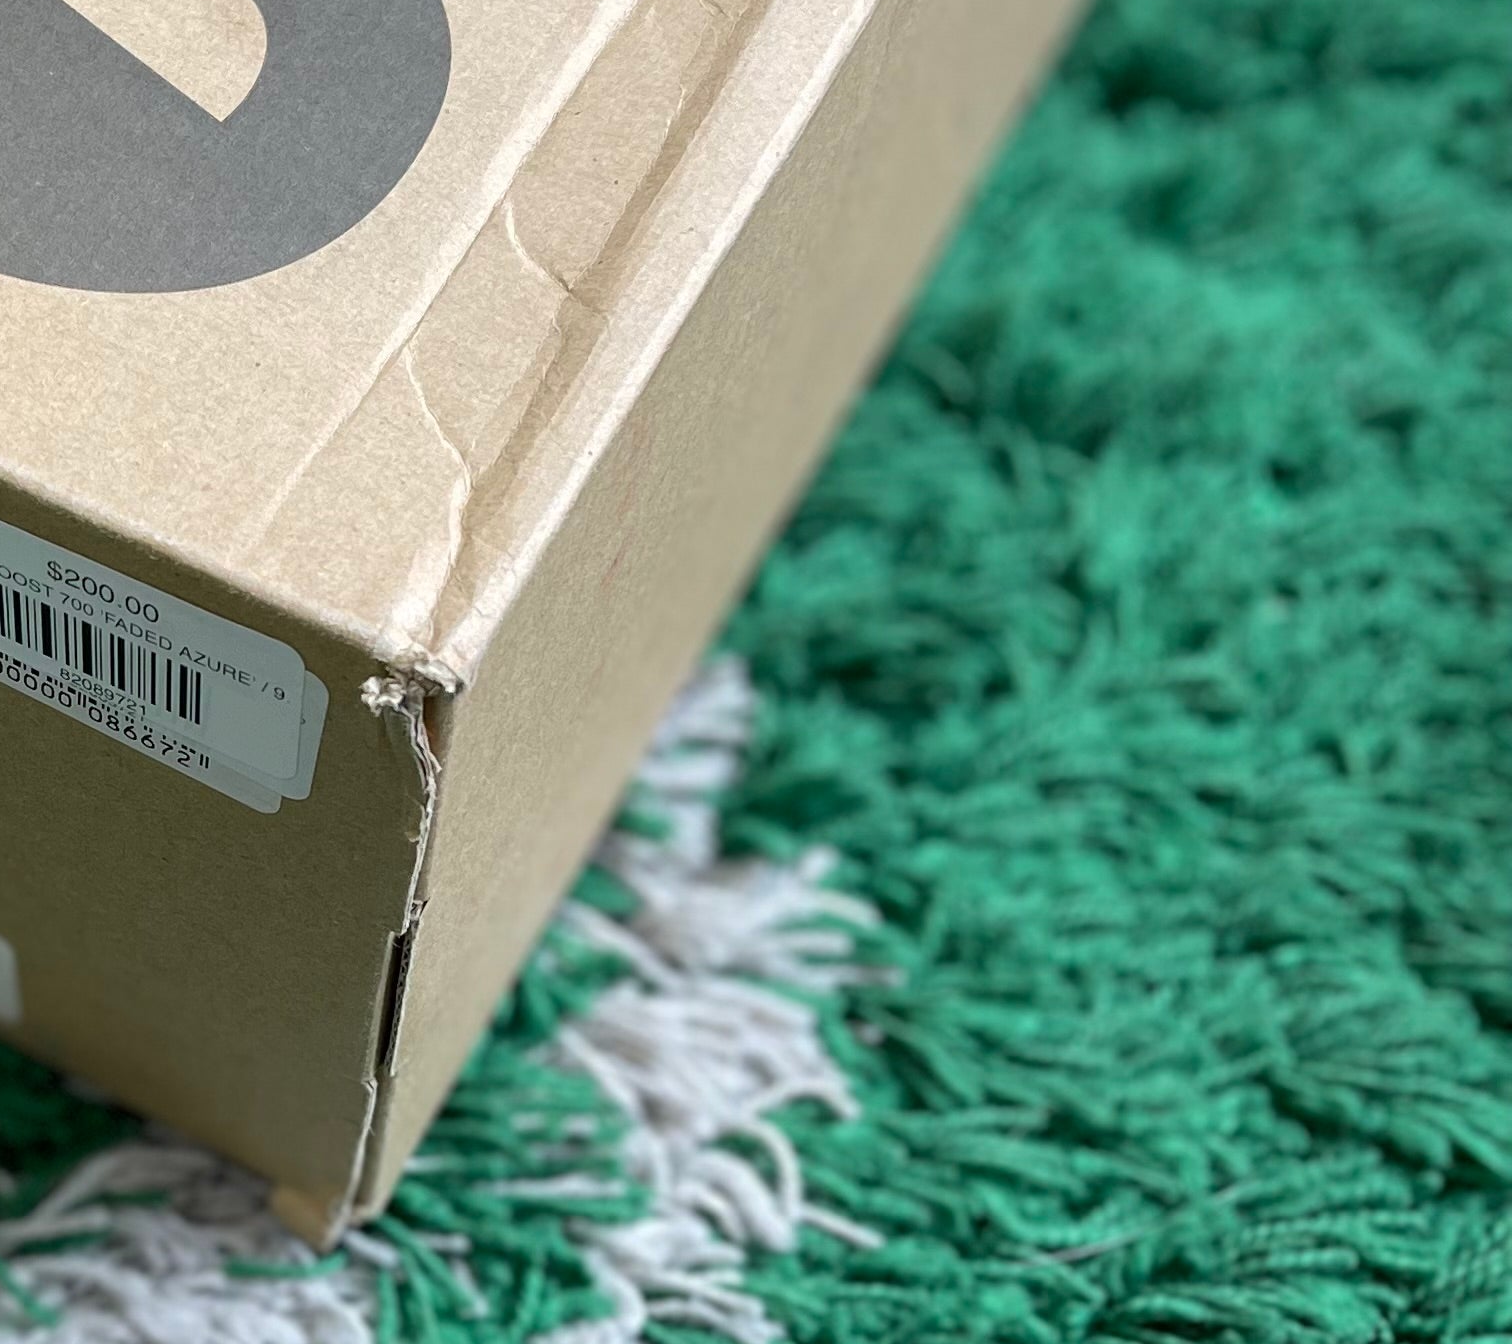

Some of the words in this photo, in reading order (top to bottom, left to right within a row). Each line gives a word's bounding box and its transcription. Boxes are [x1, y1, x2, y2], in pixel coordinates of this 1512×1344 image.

[47, 560, 160, 623] $200.00
[59, 592, 94, 616] 700
[261, 682, 269, 693] /
[88, 706, 191, 768] 086672
